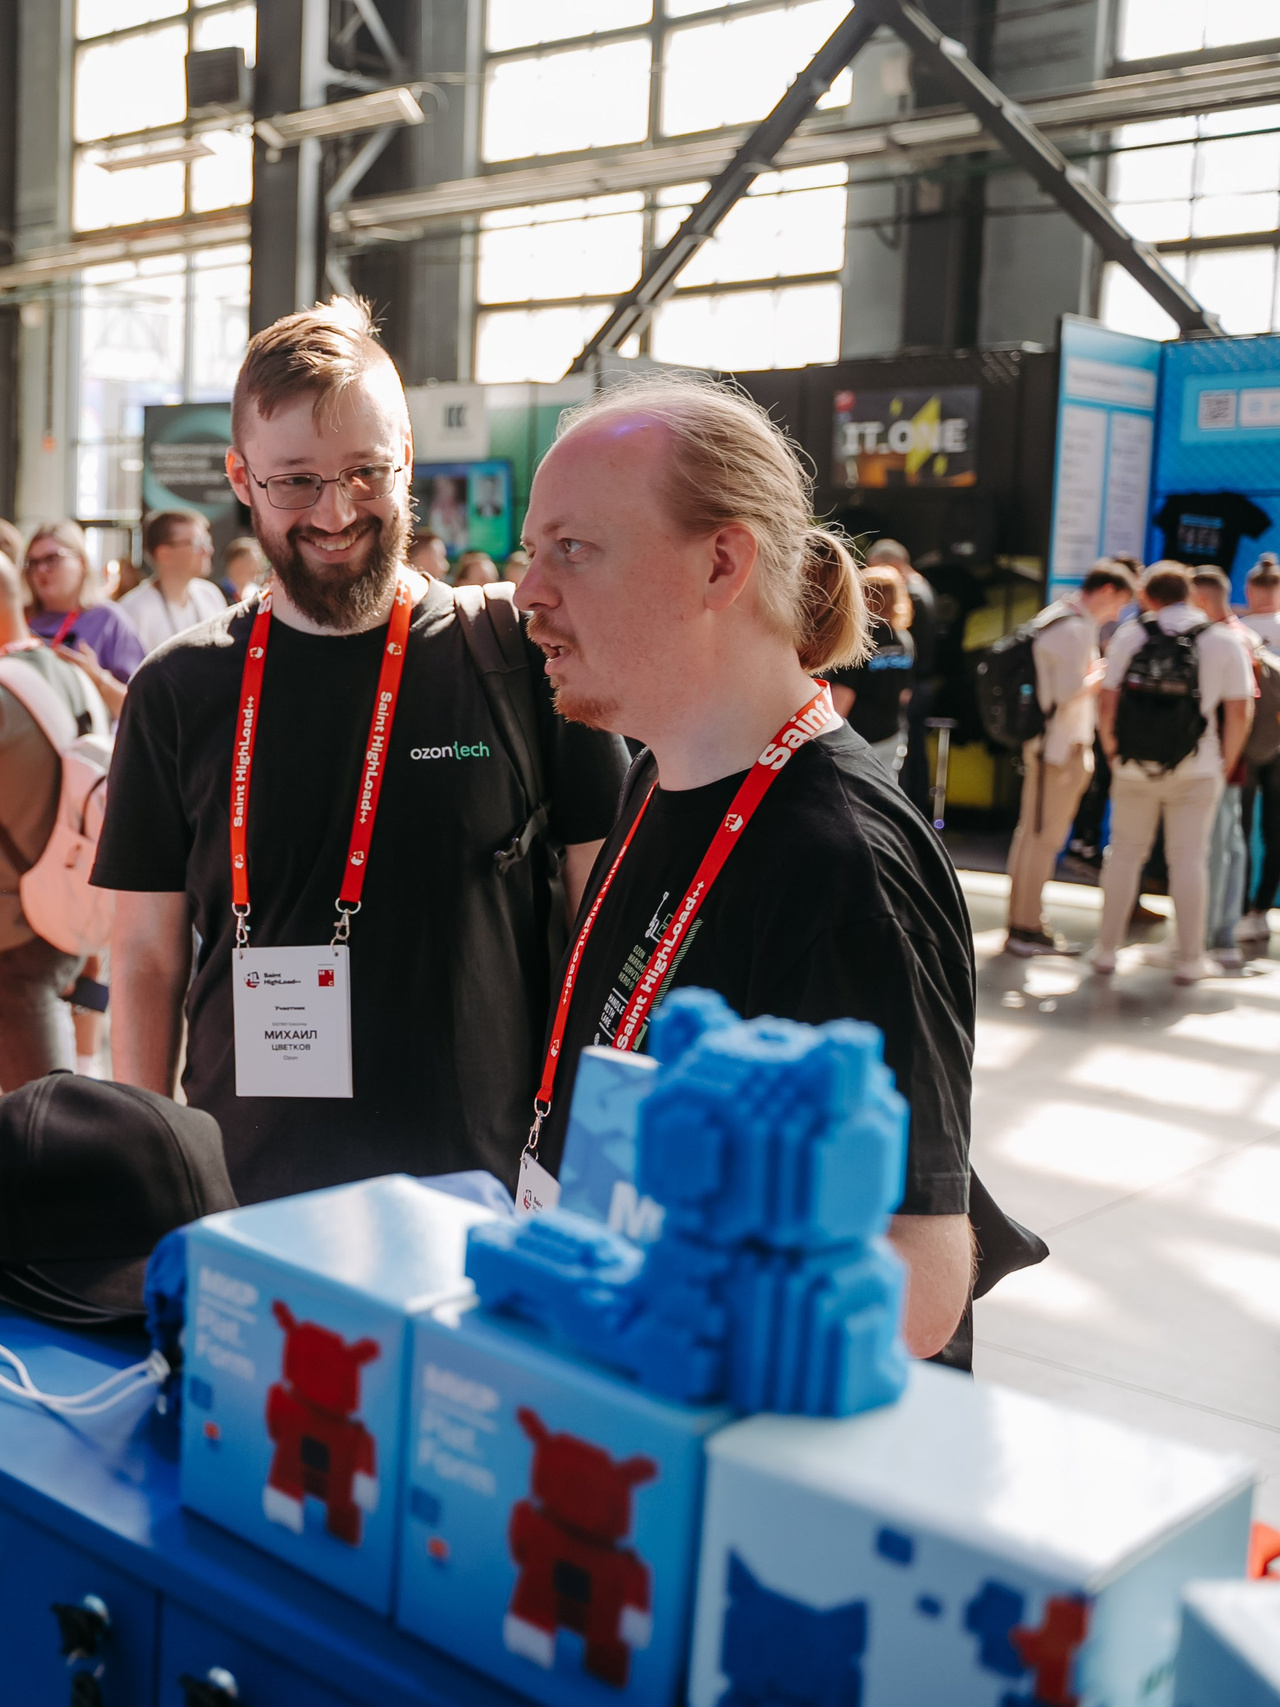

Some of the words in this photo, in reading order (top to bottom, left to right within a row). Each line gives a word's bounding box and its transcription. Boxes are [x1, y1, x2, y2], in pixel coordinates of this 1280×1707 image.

[842, 418, 969, 455] IT.ONE
[374, 691, 393, 732] Saint
[235, 695, 255, 782] HighLoad++
[758, 699, 833, 771] Saint
[359, 735, 385, 824] HighLoad++
[233, 784, 246, 828] Saint
[616, 994, 648, 1050] Saint
[640, 880, 705, 994] HighLoad++
[264, 1030, 318, 1040] МИХАИЛ
[271, 1043, 311, 1052] ЦВЕТКОВ
